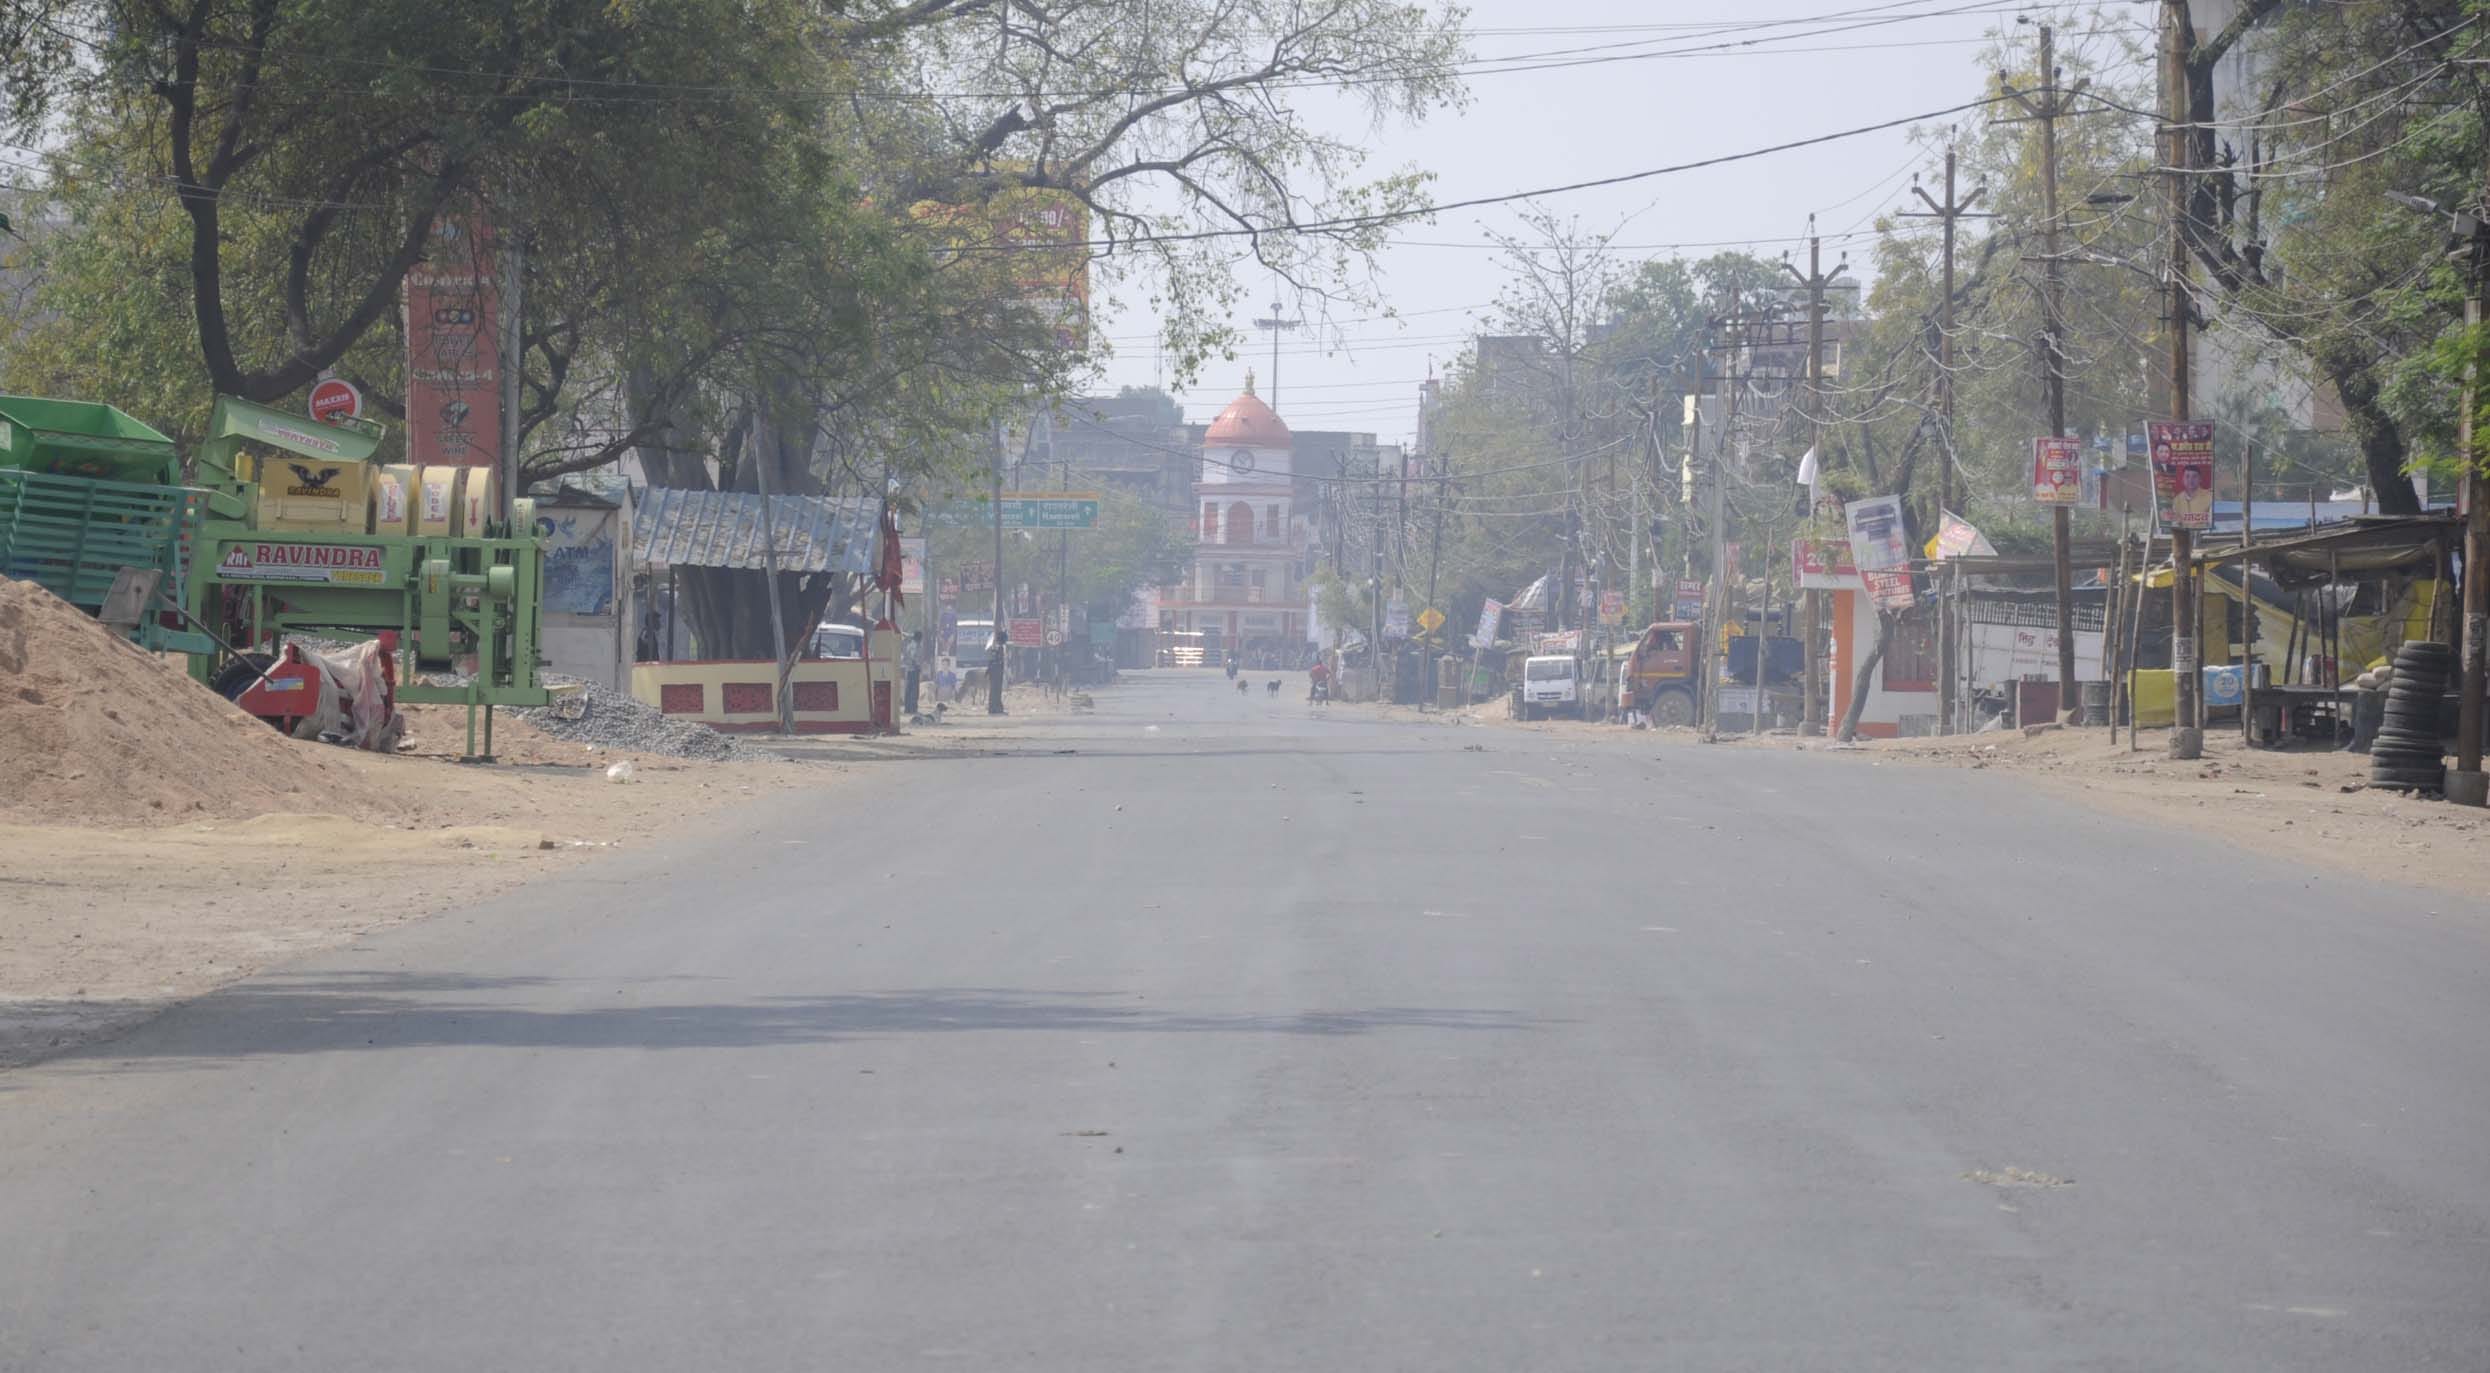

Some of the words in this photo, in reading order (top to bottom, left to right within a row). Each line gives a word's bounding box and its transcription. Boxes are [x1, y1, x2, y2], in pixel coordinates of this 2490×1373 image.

[316, 393, 350, 407] MAXXIS
[288, 486, 340, 497] RAVINDRA
[256, 545, 381, 568] RAVINDRA
[1874, 577, 1901, 590] STEEL
